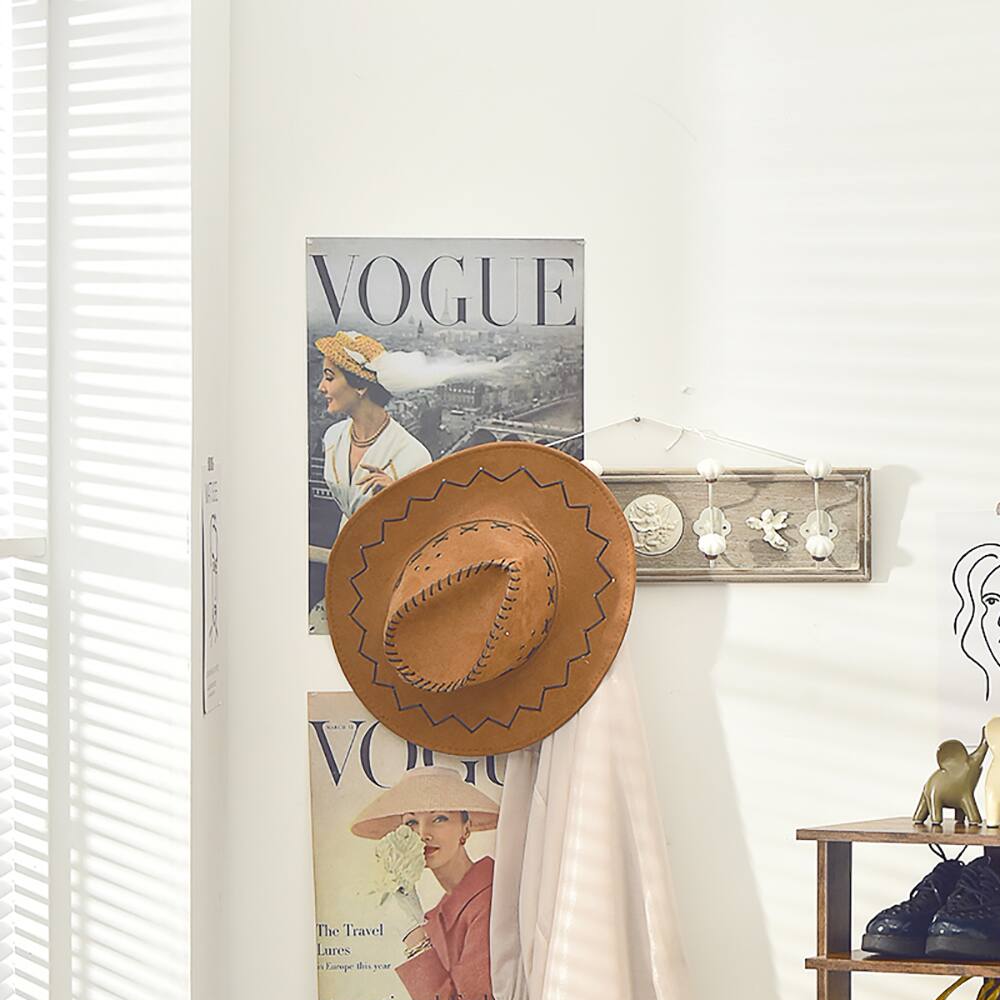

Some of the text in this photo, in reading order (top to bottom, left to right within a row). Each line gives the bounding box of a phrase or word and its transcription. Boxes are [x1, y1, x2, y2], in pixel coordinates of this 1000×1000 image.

[308, 254, 577, 327] VOGUE
[317, 923, 384, 938] The Travel
[317, 943, 352, 956] Lures
